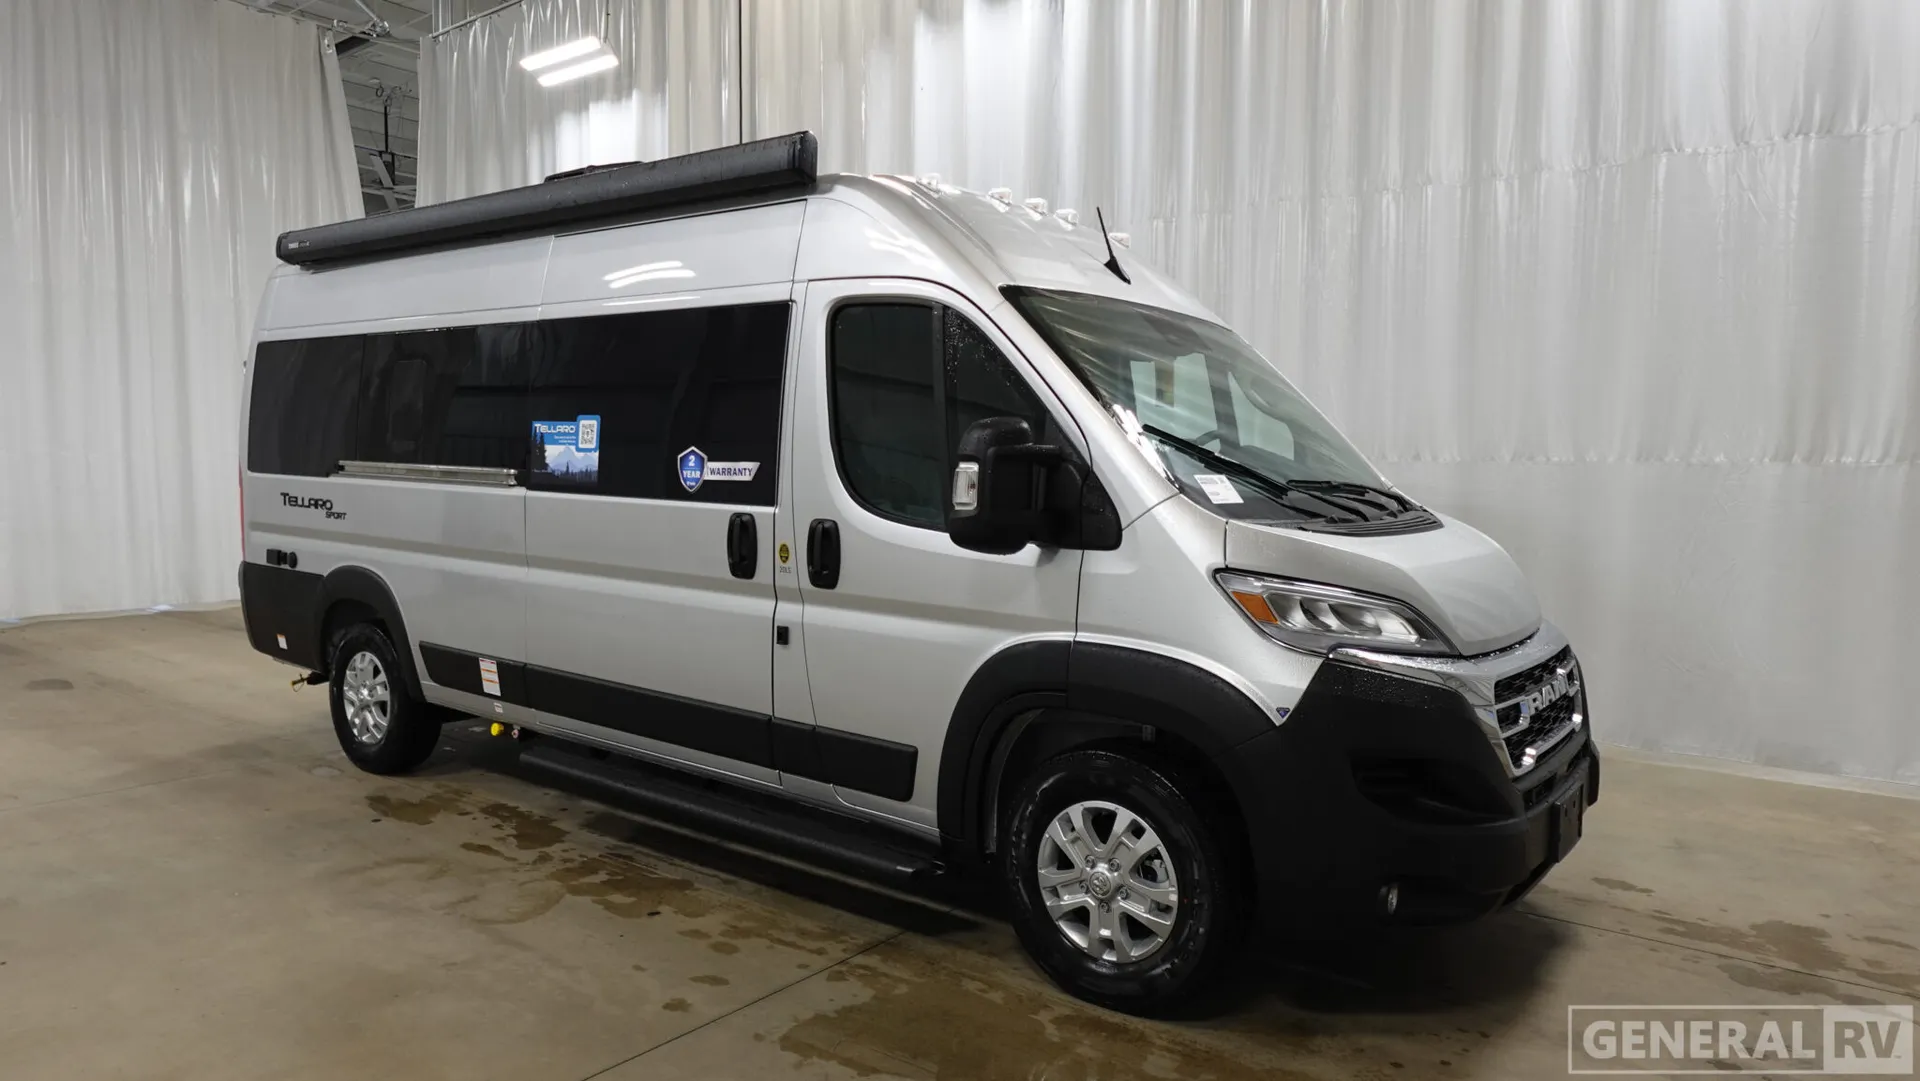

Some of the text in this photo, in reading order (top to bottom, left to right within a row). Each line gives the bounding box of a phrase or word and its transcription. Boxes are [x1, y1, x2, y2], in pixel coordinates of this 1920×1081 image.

[534, 423, 576, 433] TELLARO
[688, 455, 696, 467] 2
[683, 470, 701, 479] YEAR
[709, 467, 753, 477] WARRANTY
[280, 492, 333, 511] TELLARO
[325, 510, 347, 520] SPORT
[1528, 674, 1568, 717] RAM
